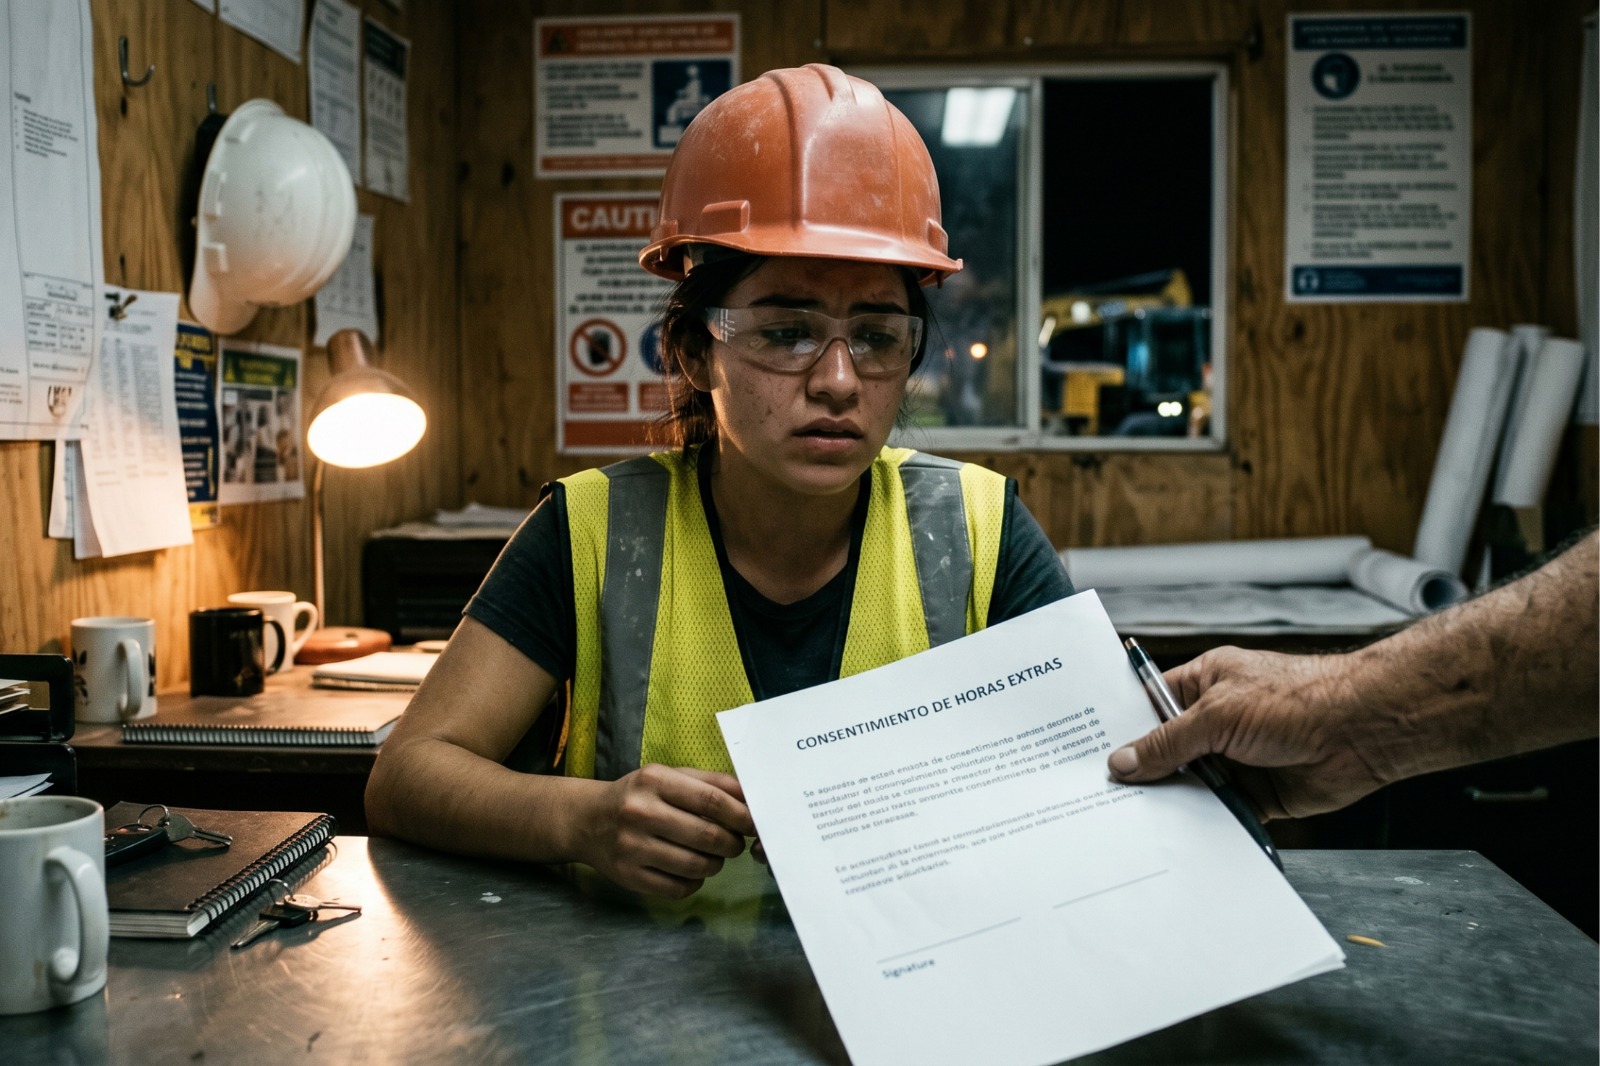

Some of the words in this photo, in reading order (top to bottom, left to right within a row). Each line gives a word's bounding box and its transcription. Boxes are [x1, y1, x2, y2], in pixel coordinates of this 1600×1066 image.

[571, 205, 657, 231] CAUTI
[796, 705, 929, 751] CONSENTIMIENTO
[932, 697, 953, 713] DE
[955, 679, 1006, 706] HORAS
[1007, 657, 1063, 687] EXTRAS
[1084, 707, 1095, 715] de
